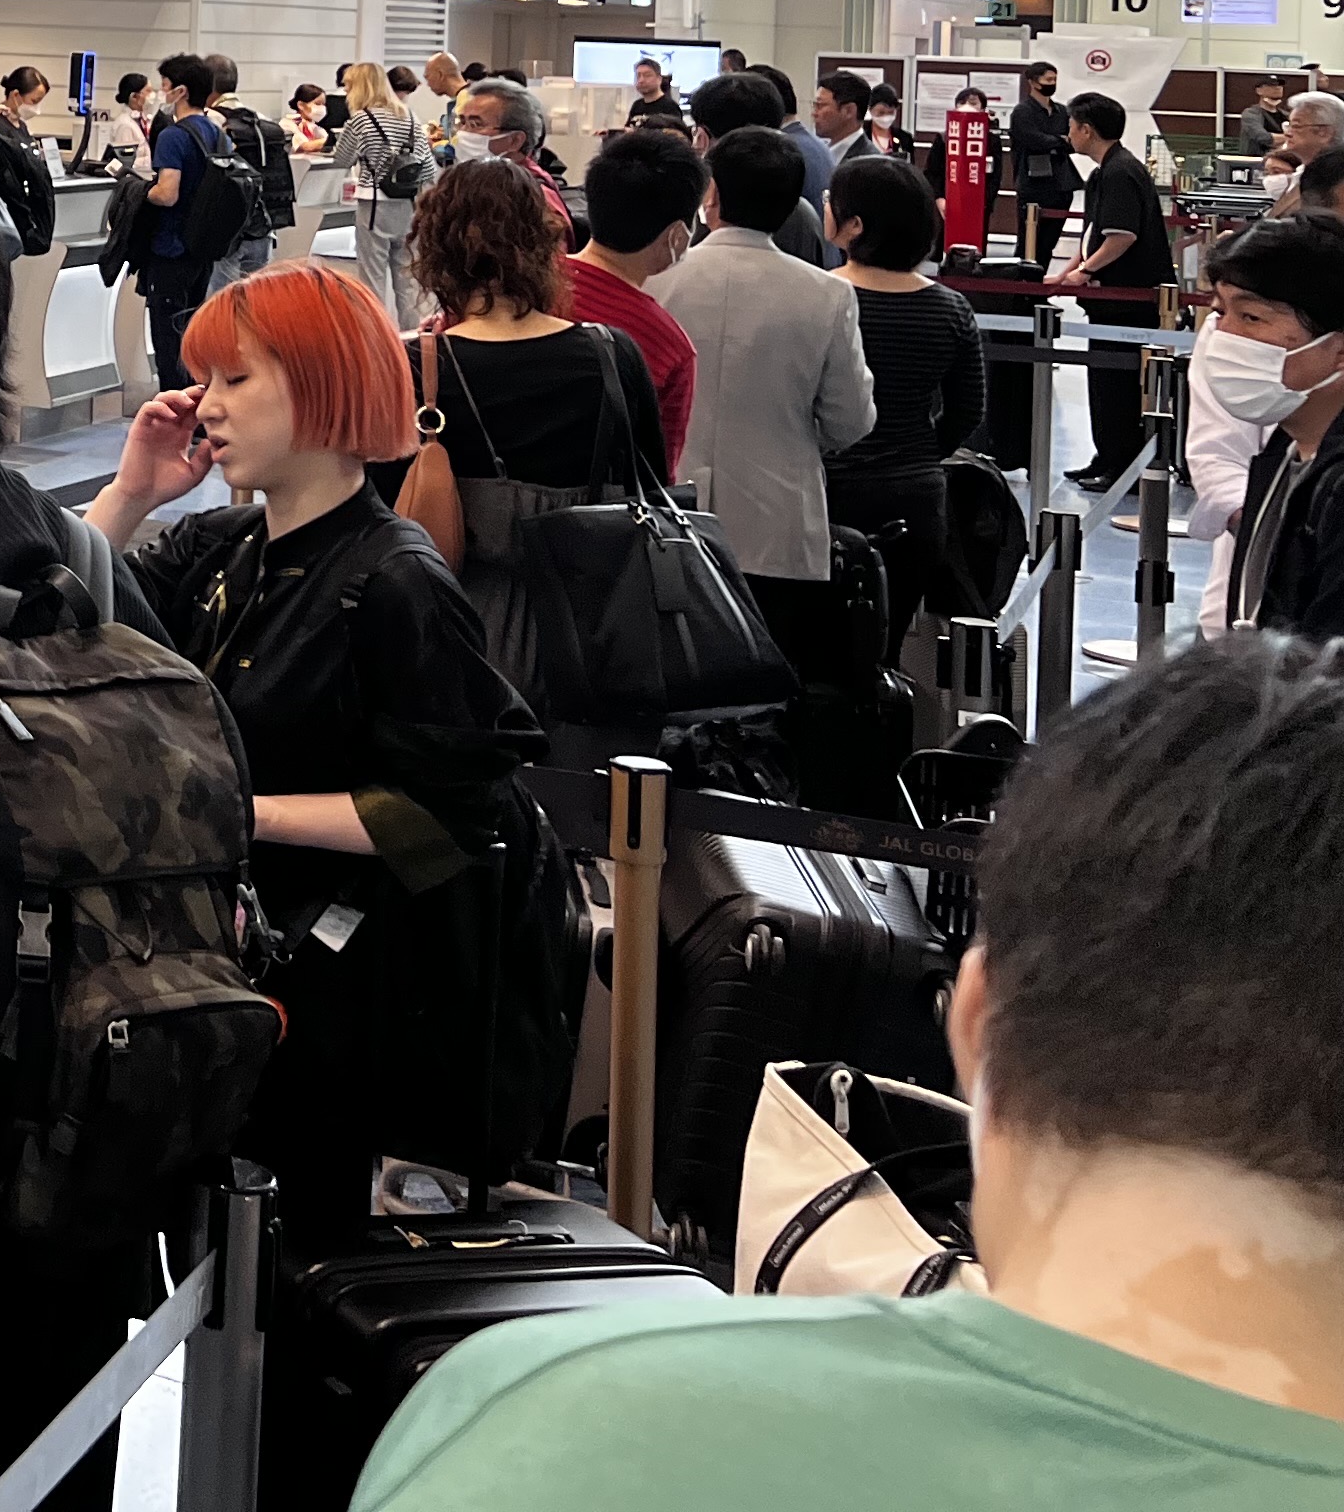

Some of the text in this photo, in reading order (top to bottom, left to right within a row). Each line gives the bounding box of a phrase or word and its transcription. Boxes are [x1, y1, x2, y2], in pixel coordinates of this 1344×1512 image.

[991, 2, 1012, 17] 21
[948, 120, 960, 156] 出口
[966, 121, 984, 157] 出口
[968, 162, 979, 185] EXIT
[879, 835, 976, 862] JAL GLOB
